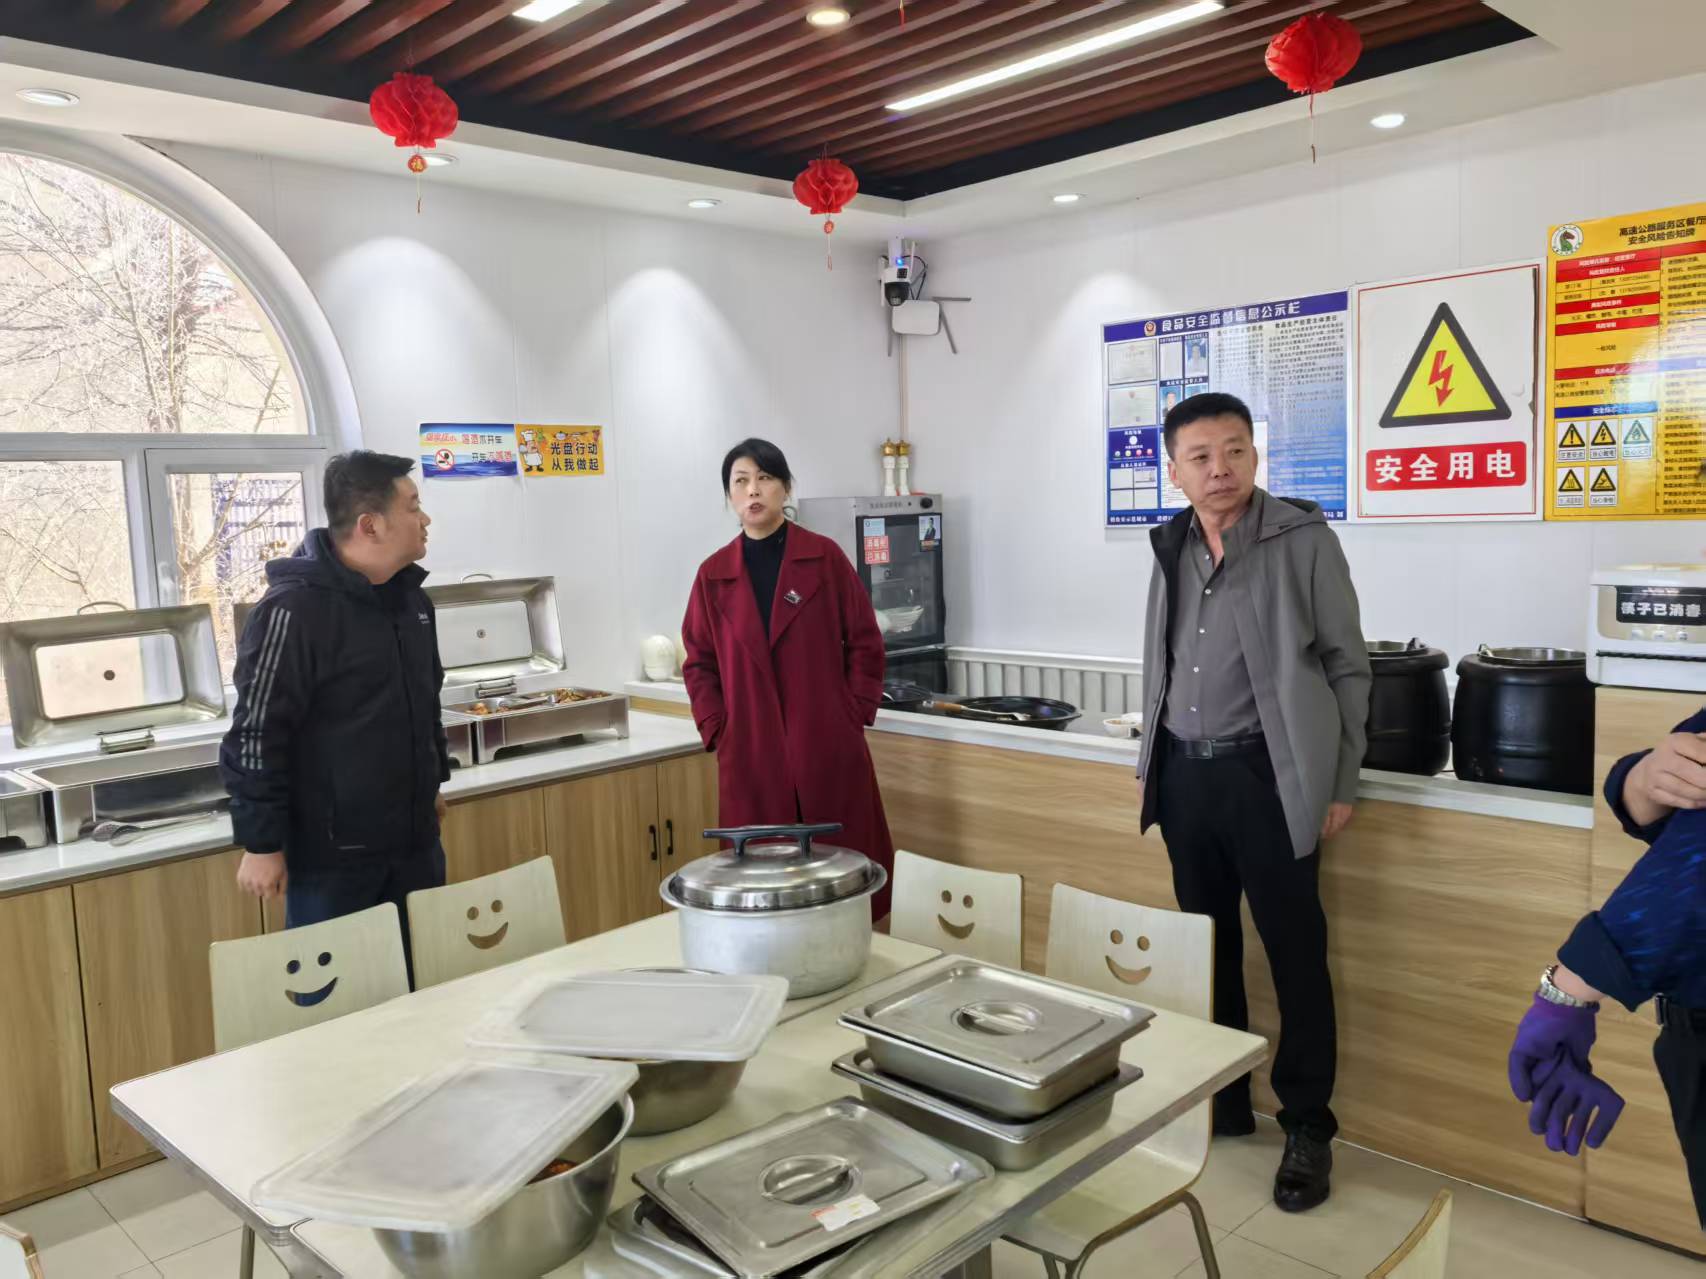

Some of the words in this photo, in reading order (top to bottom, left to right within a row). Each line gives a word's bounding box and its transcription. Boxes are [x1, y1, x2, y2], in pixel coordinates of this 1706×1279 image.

[1162, 300, 1301, 333] 食品安全监督信息公示栏
[551, 442, 598, 456] 光盘行动
[551, 458, 599, 471] 从我做起
[1374, 449, 1516, 484] 安全用电
[1621, 601, 1701, 618] 筷子已消毒
